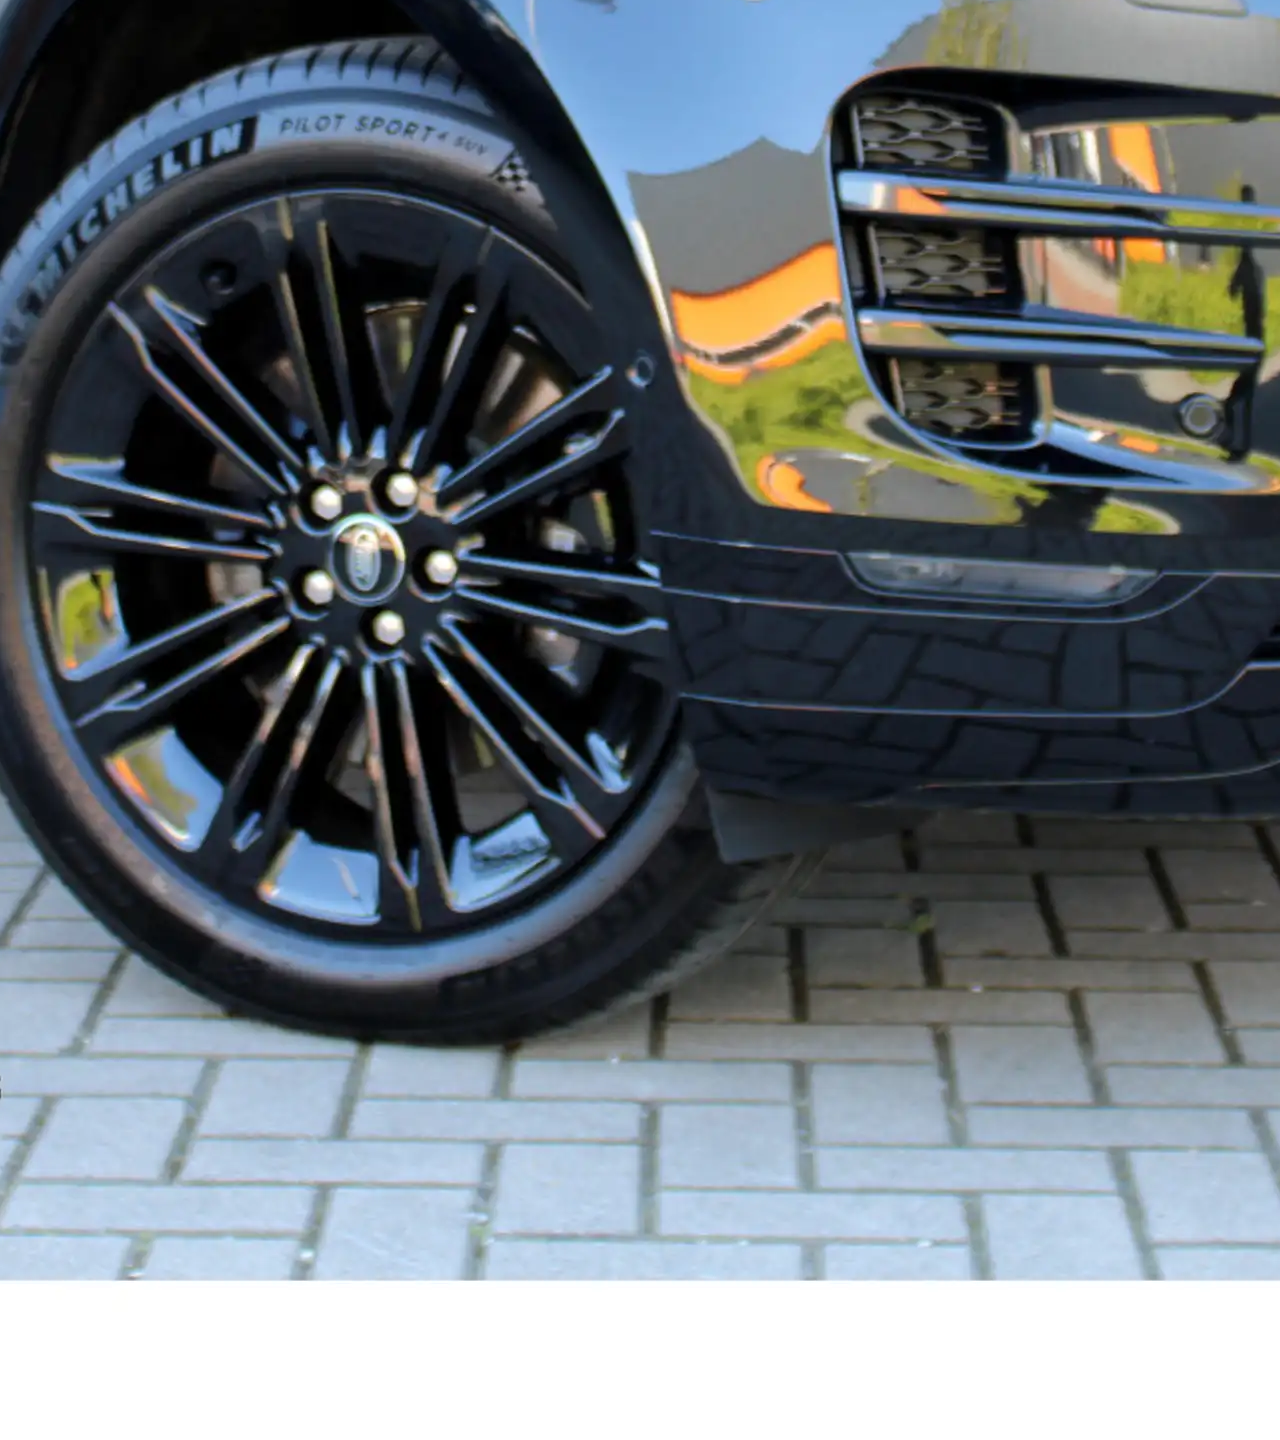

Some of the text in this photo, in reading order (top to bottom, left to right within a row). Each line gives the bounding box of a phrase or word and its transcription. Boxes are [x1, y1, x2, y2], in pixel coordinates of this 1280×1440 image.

[280, 114, 346, 135] PILOT
[354, 116, 436, 144] SPORT
[28, 119, 244, 302] MICHELIN
